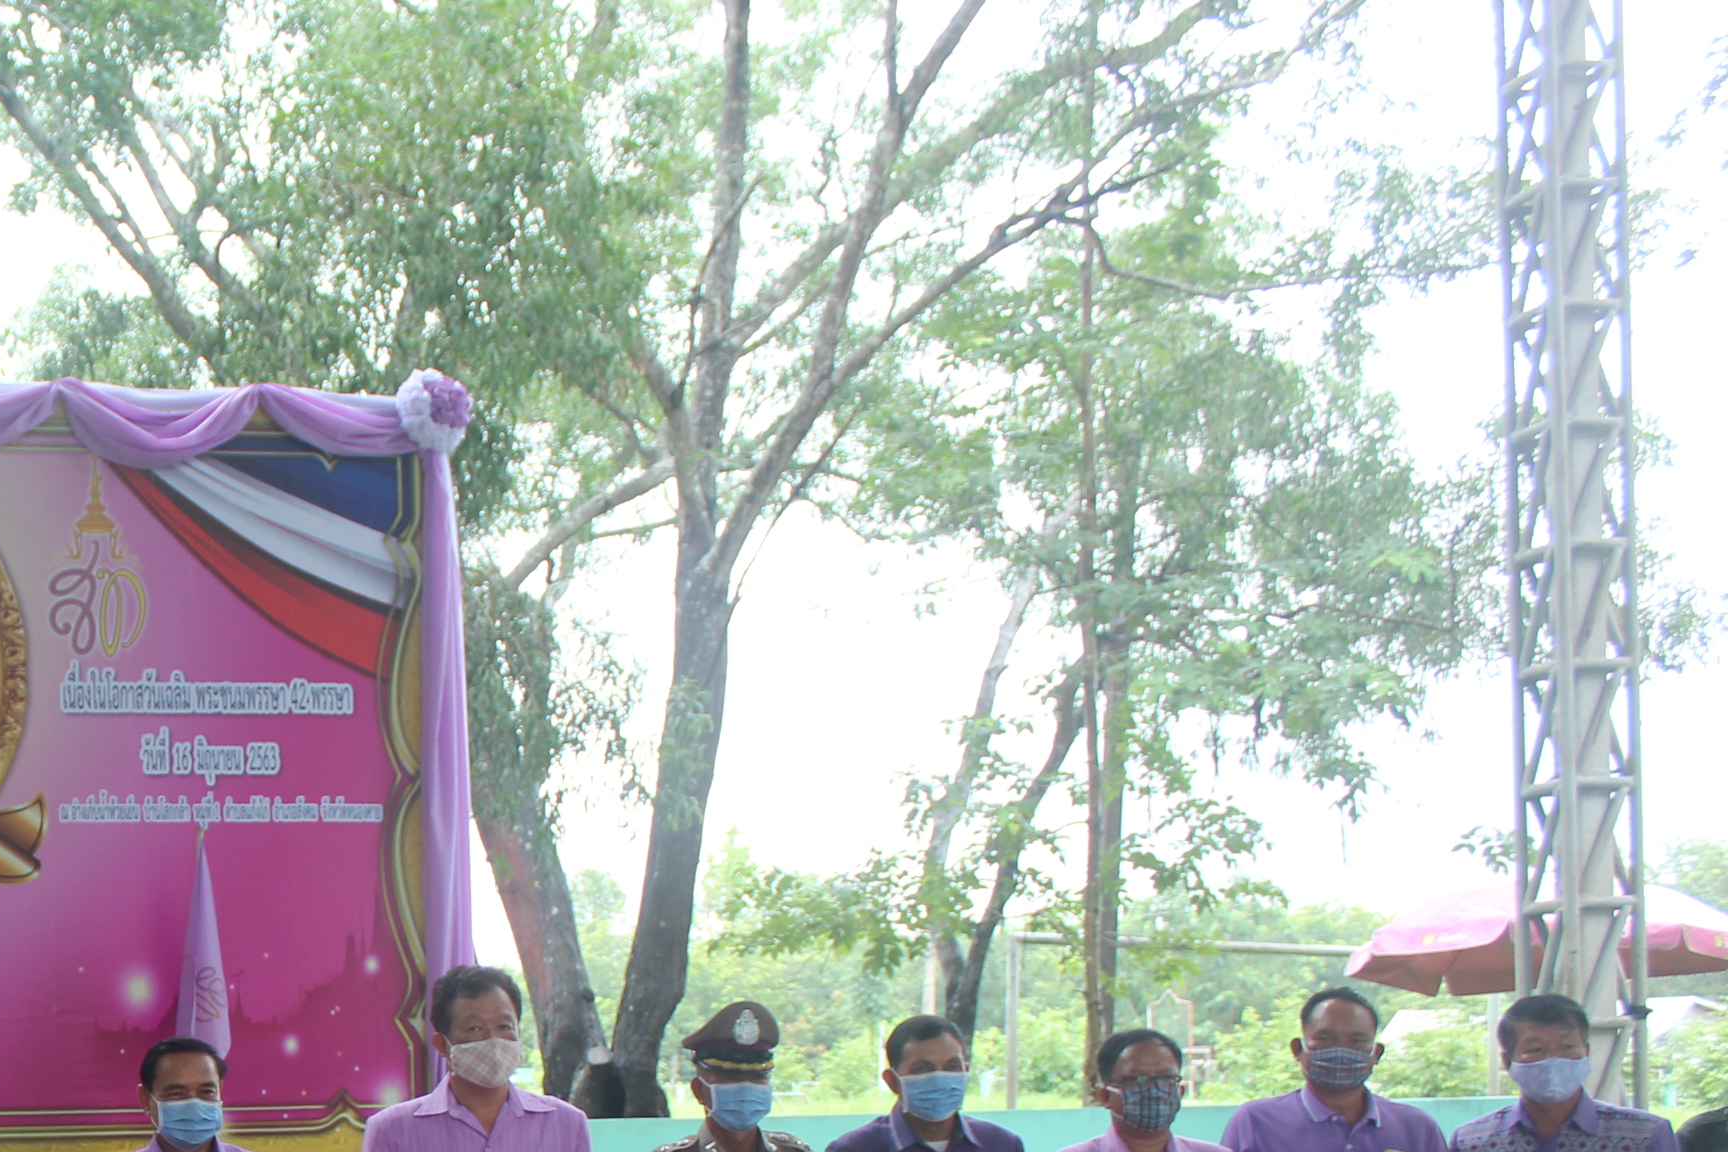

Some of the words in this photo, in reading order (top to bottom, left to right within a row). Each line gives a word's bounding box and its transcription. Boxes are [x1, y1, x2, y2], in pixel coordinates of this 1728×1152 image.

[61, 660, 193, 713] เนื่องในโอกาสวันเฉลิม
[195, 683, 288, 713] พระชนมพรรษา
[310, 683, 353, 713] พรรษา
[141, 726, 169, 774] วันที่
[173, 742, 191, 774] 16
[194, 735, 244, 785] มิถุนายน
[246, 743, 279, 774] 2563
